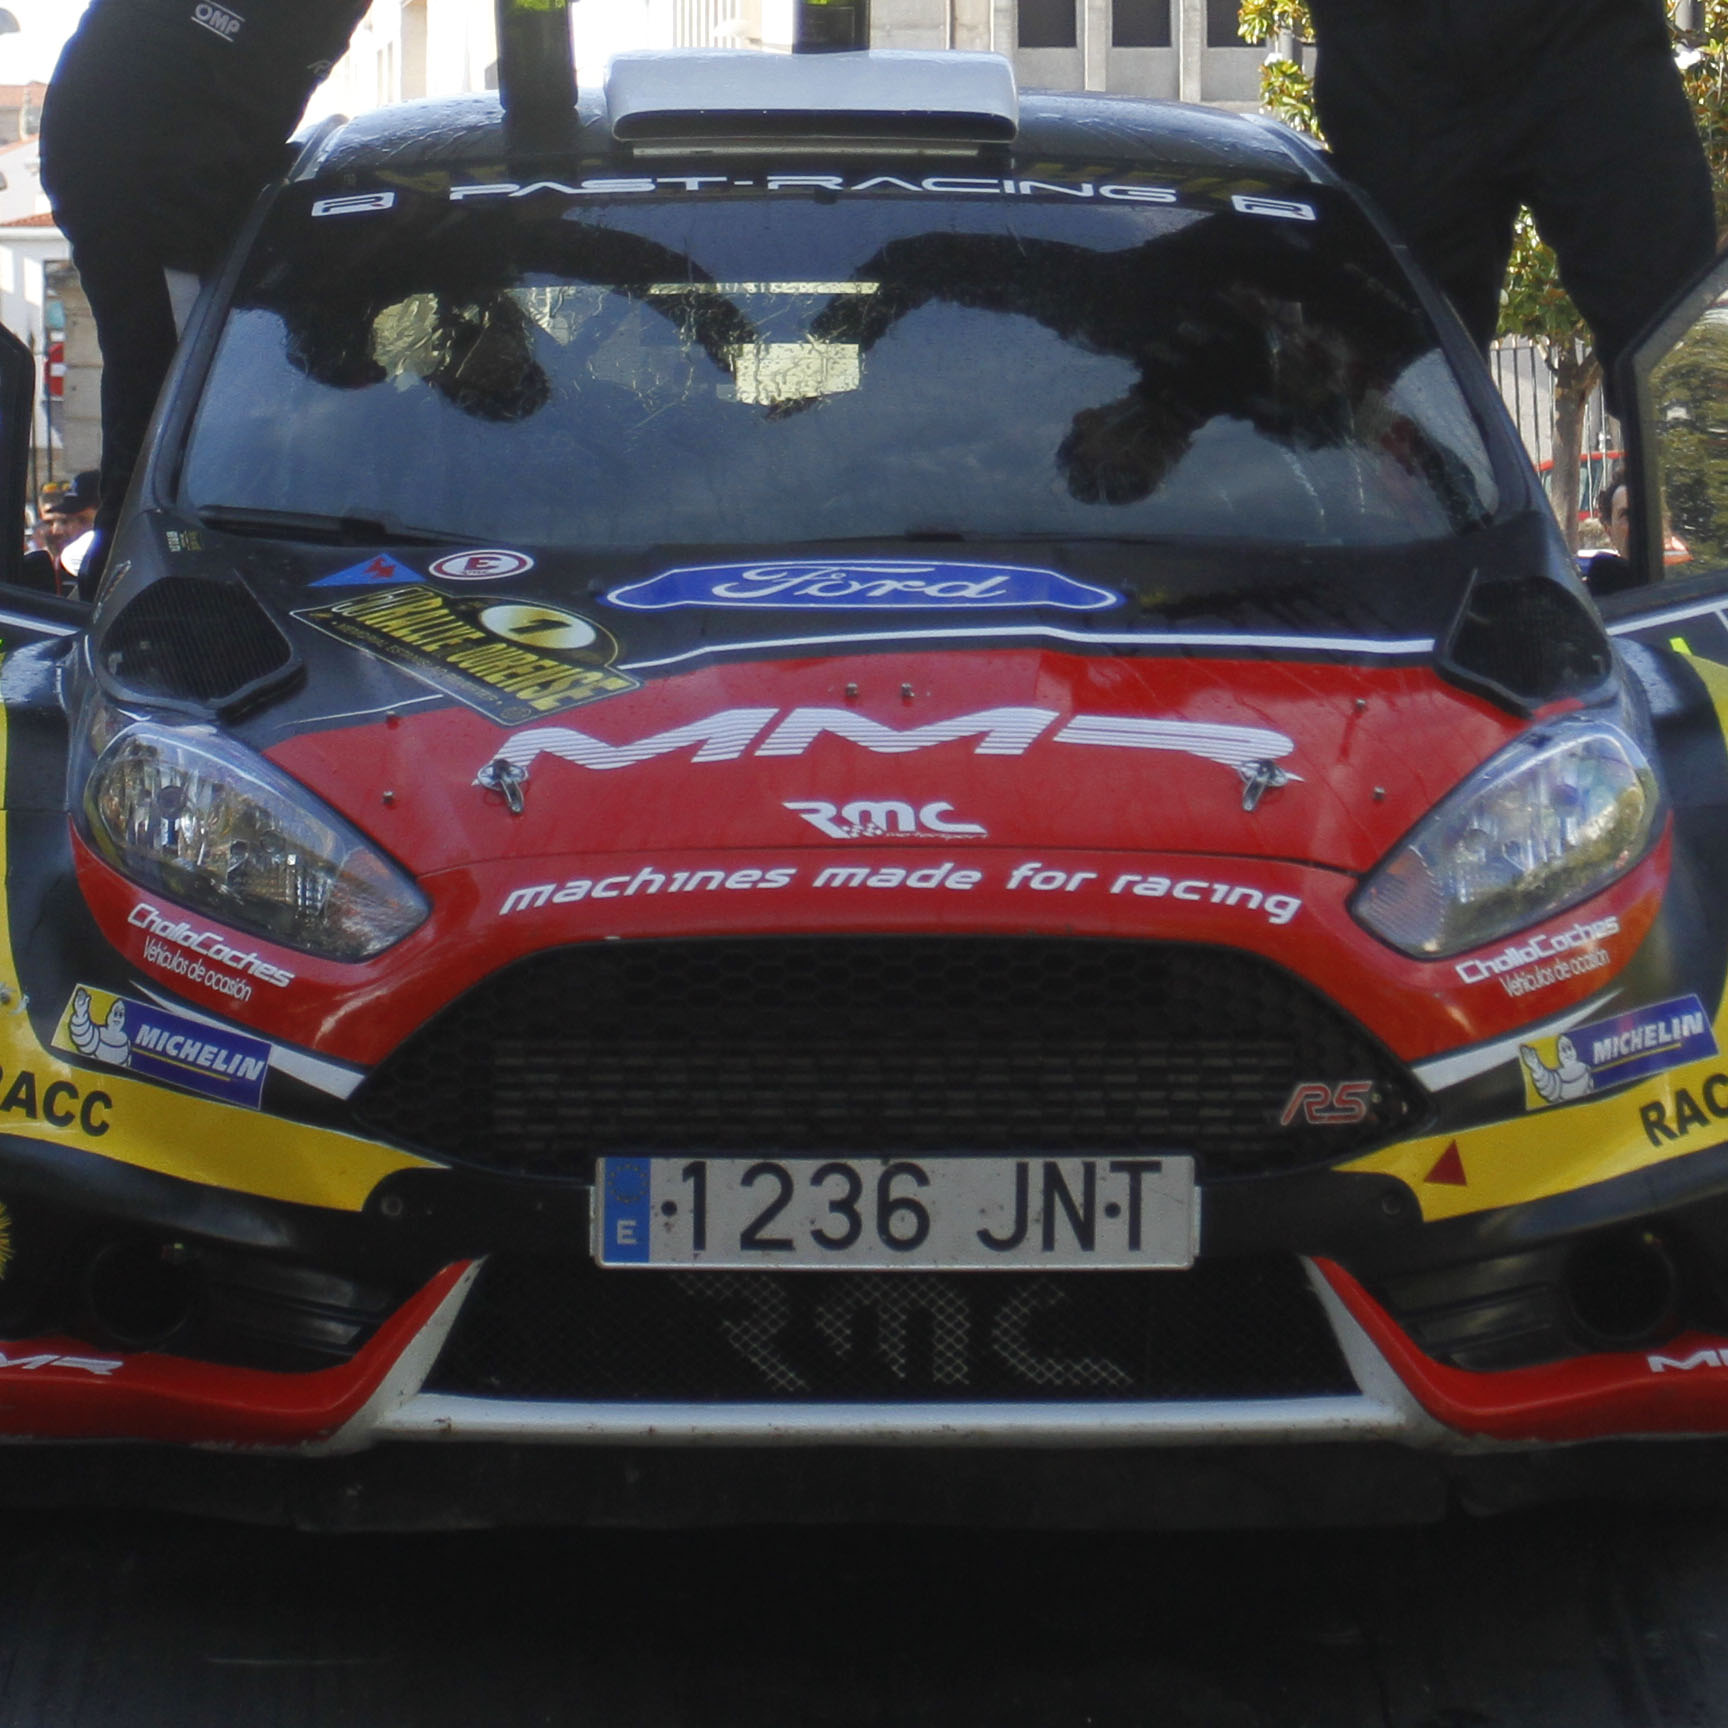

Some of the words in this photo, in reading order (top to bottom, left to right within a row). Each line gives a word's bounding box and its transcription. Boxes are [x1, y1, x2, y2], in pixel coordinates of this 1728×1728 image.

[194, 1, 242, 36] OMP
[711, 565, 1011, 601] Ford
[498, 865, 798, 917] machines
[811, 863, 984, 891] made
[1005, 862, 1098, 893] for
[1108, 871, 1303, 925] racing
[142, 935, 190, 974] Vehículos
[187, 958, 206, 982] de
[204, 969, 253, 1003] ocasión
[135, 1023, 265, 1082] MICHELIN
[1592, 1011, 1704, 1065] MICHELIN
[1280, 1079, 1373, 1126] RS
[616, 1219, 637, 1246] E
[678, 1160, 932, 1253] 1236
[976, 1160, 1162, 1253] JNT
